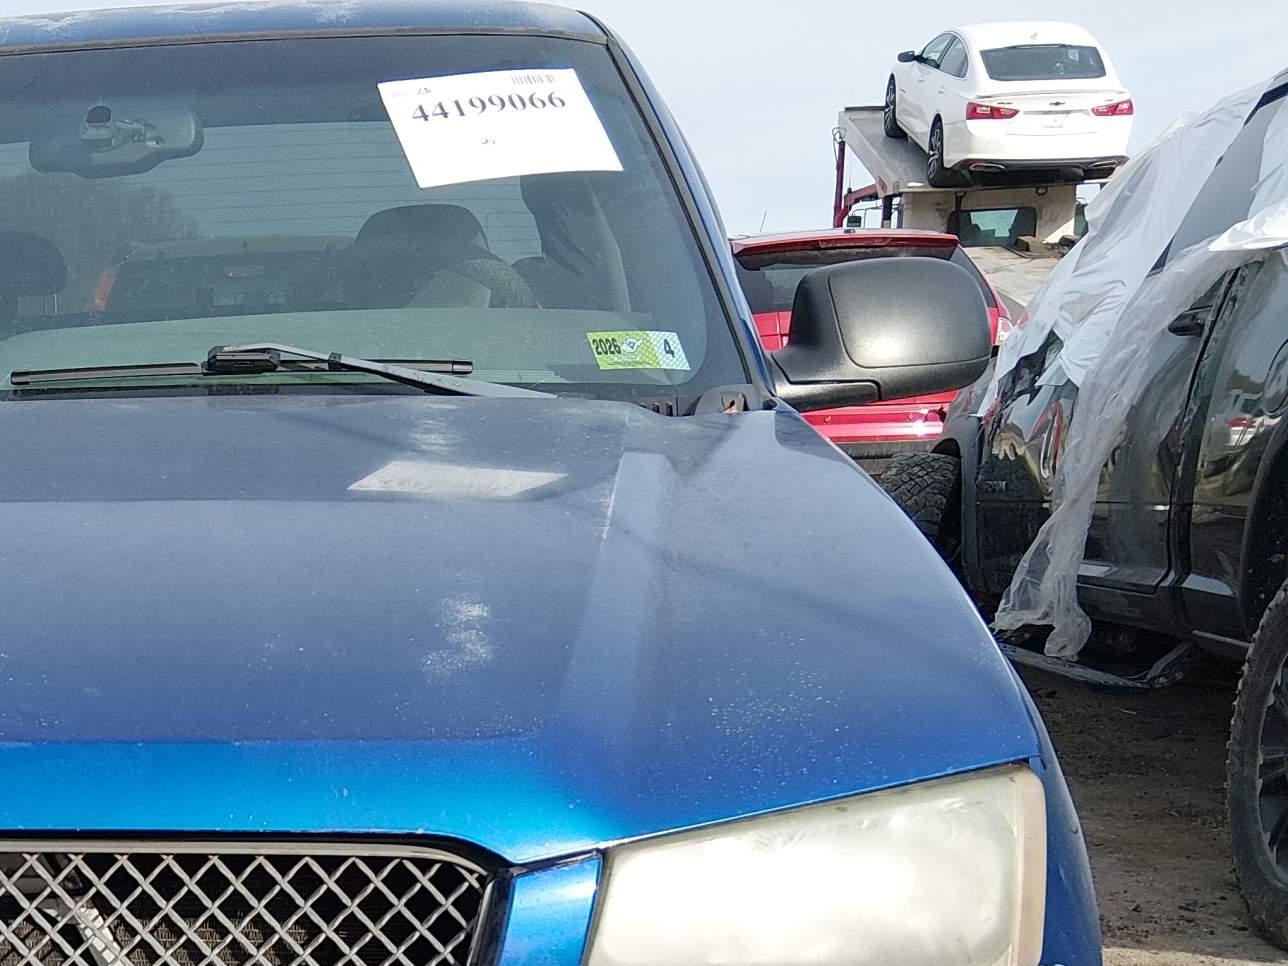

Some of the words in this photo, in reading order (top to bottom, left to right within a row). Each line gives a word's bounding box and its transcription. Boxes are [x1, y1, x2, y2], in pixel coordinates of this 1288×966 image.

[412, 90, 566, 122] 44199066
[592, 337, 621, 356] 2026
[663, 338, 675, 358] 4
